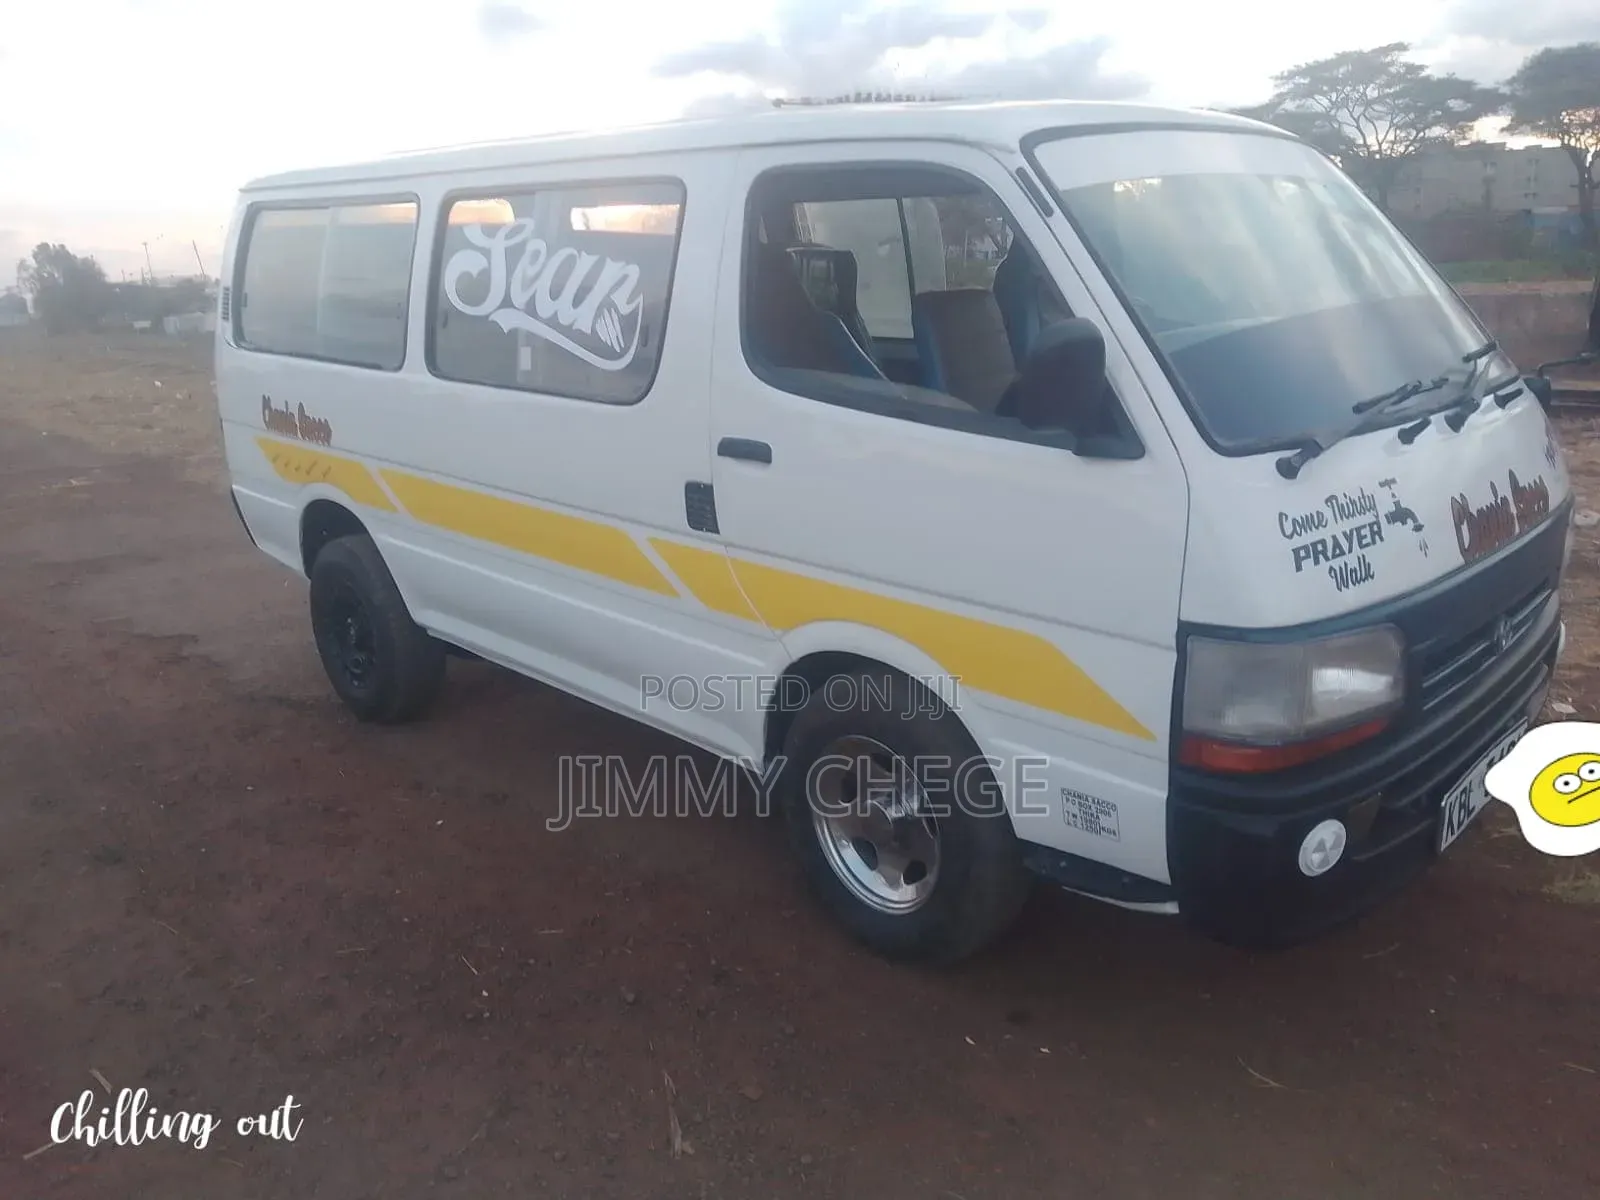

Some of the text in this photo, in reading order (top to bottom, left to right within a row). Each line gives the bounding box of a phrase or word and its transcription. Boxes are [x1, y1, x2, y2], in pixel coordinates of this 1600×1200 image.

[1278, 486, 1379, 540] Come Thirsty
[1292, 520, 1384, 573] PRAYER
[1328, 553, 1375, 592] Walk
[1062, 788, 1117, 812] CHANIA SACCO
[1078, 801, 1092, 810] BOX
